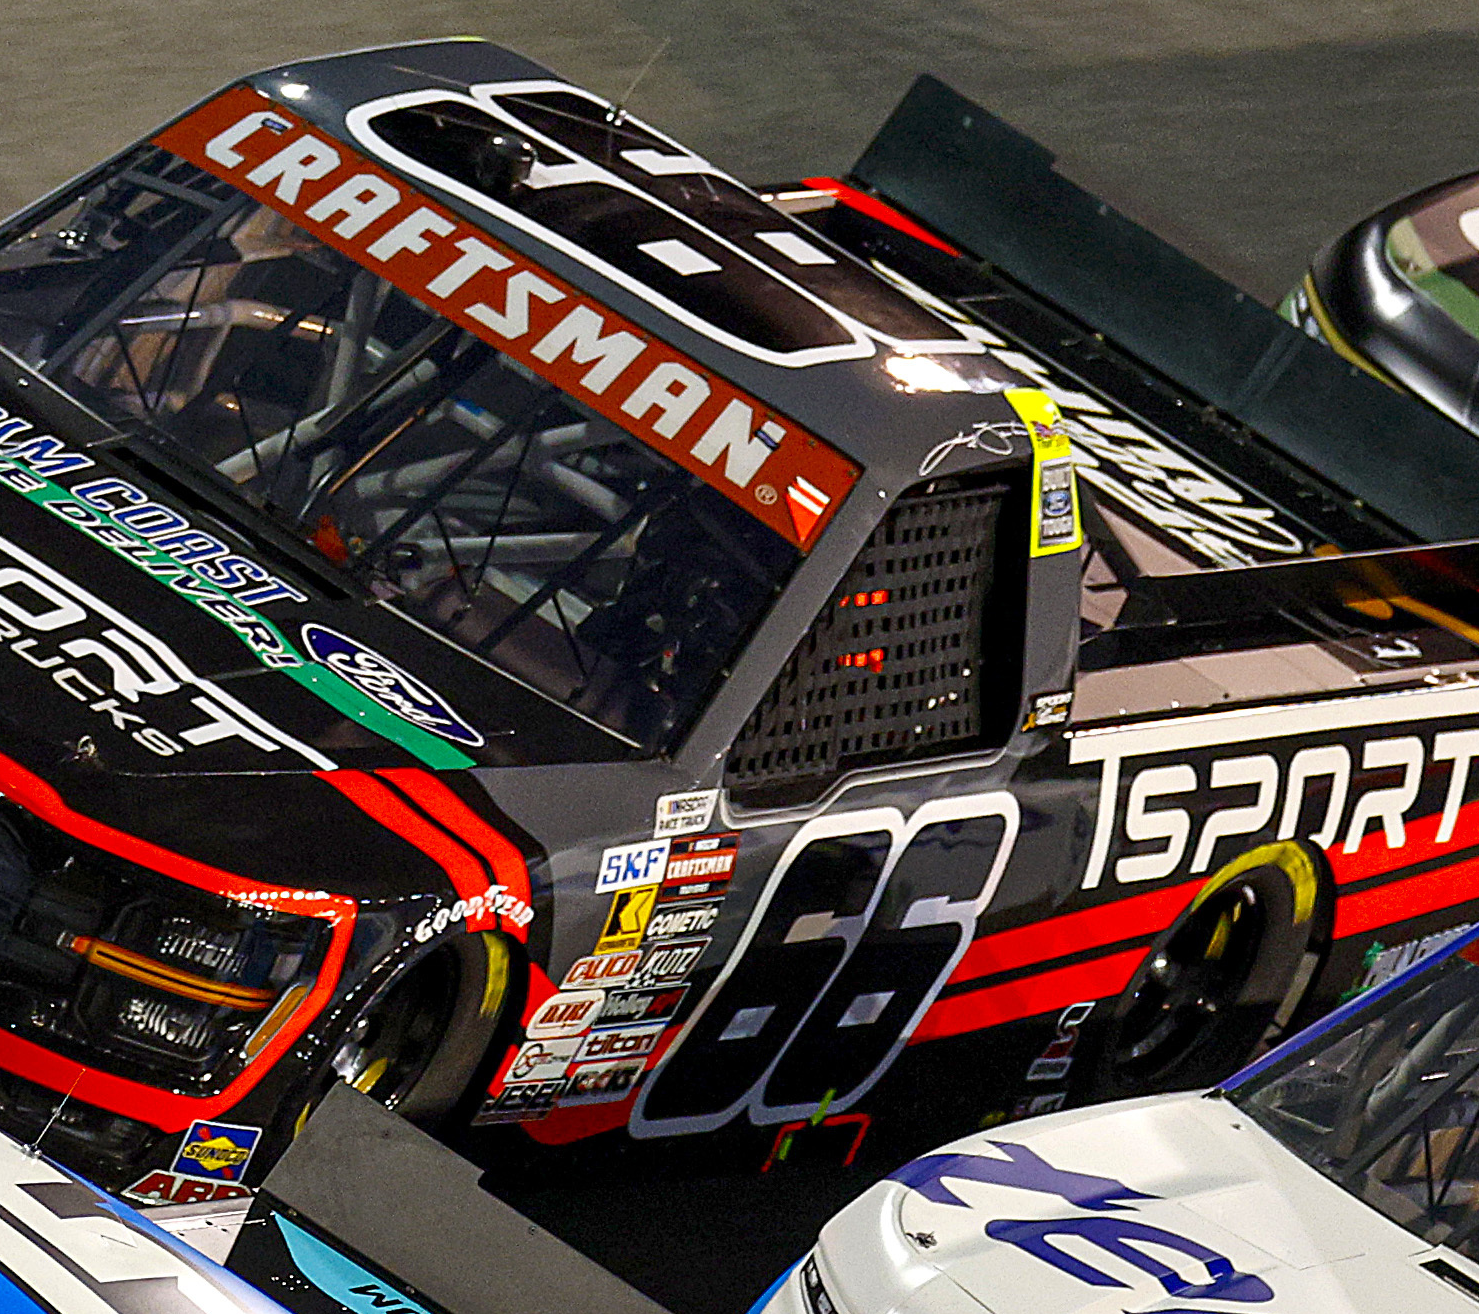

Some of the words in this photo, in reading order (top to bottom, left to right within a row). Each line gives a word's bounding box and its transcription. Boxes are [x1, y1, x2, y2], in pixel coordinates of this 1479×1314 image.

[205, 111, 787, 486] CRAFTSMAN
[68, 477, 310, 607] COAST
[324, 646, 454, 730] Ford
[602, 846, 665, 886] SKF
[667, 854, 734, 880] CRAFTSMAN
[647, 908, 718, 936] COMETIC
[627, 791, 1019, 1139] 66
[649, 947, 701, 976] KLOTZ
[185, 1143, 248, 1164] SUNOCO
[127, 1172, 252, 1204] ARP
